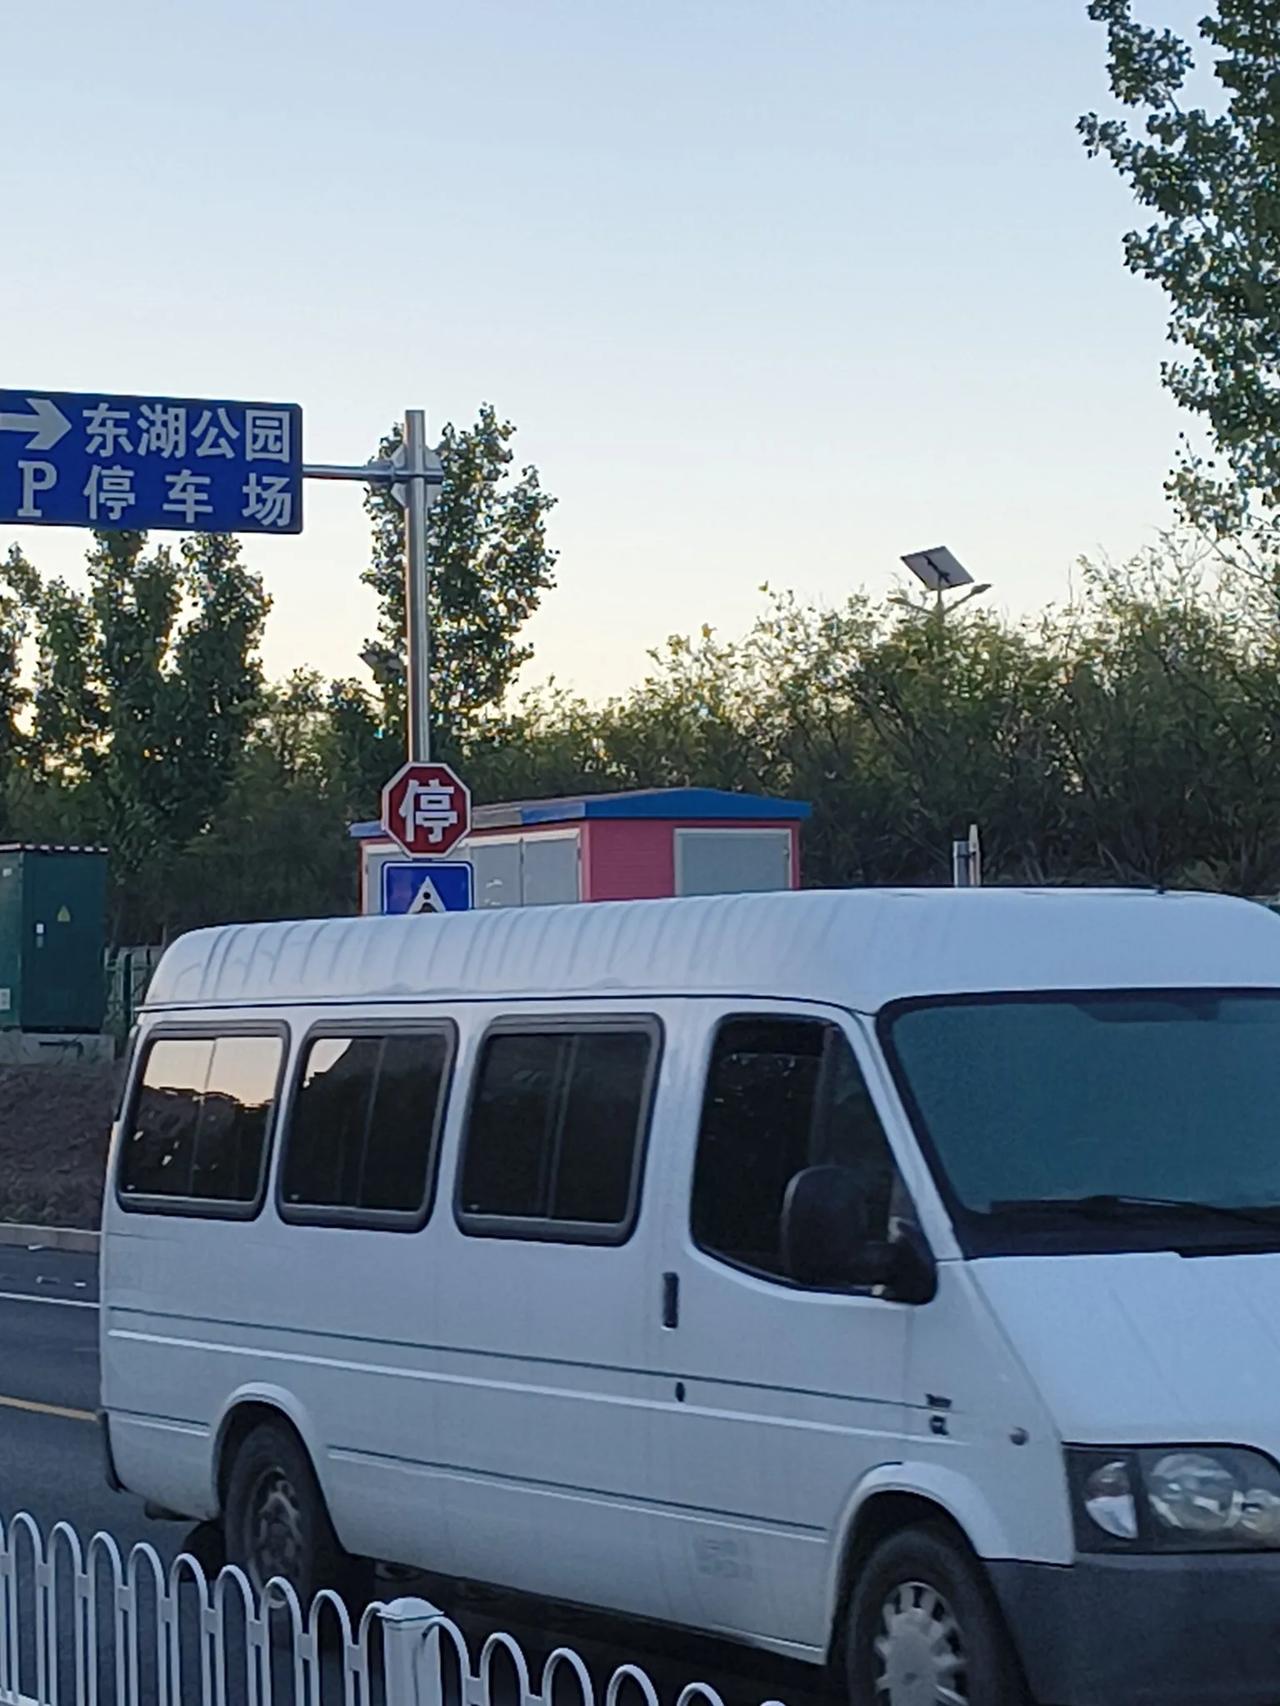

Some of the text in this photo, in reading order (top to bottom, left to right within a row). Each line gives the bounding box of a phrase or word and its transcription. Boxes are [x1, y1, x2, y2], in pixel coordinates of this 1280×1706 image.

[82, 402, 291, 463] 东湖公园
[17, 460, 292, 527] P 停车场
[398, 778, 458, 843] 停
